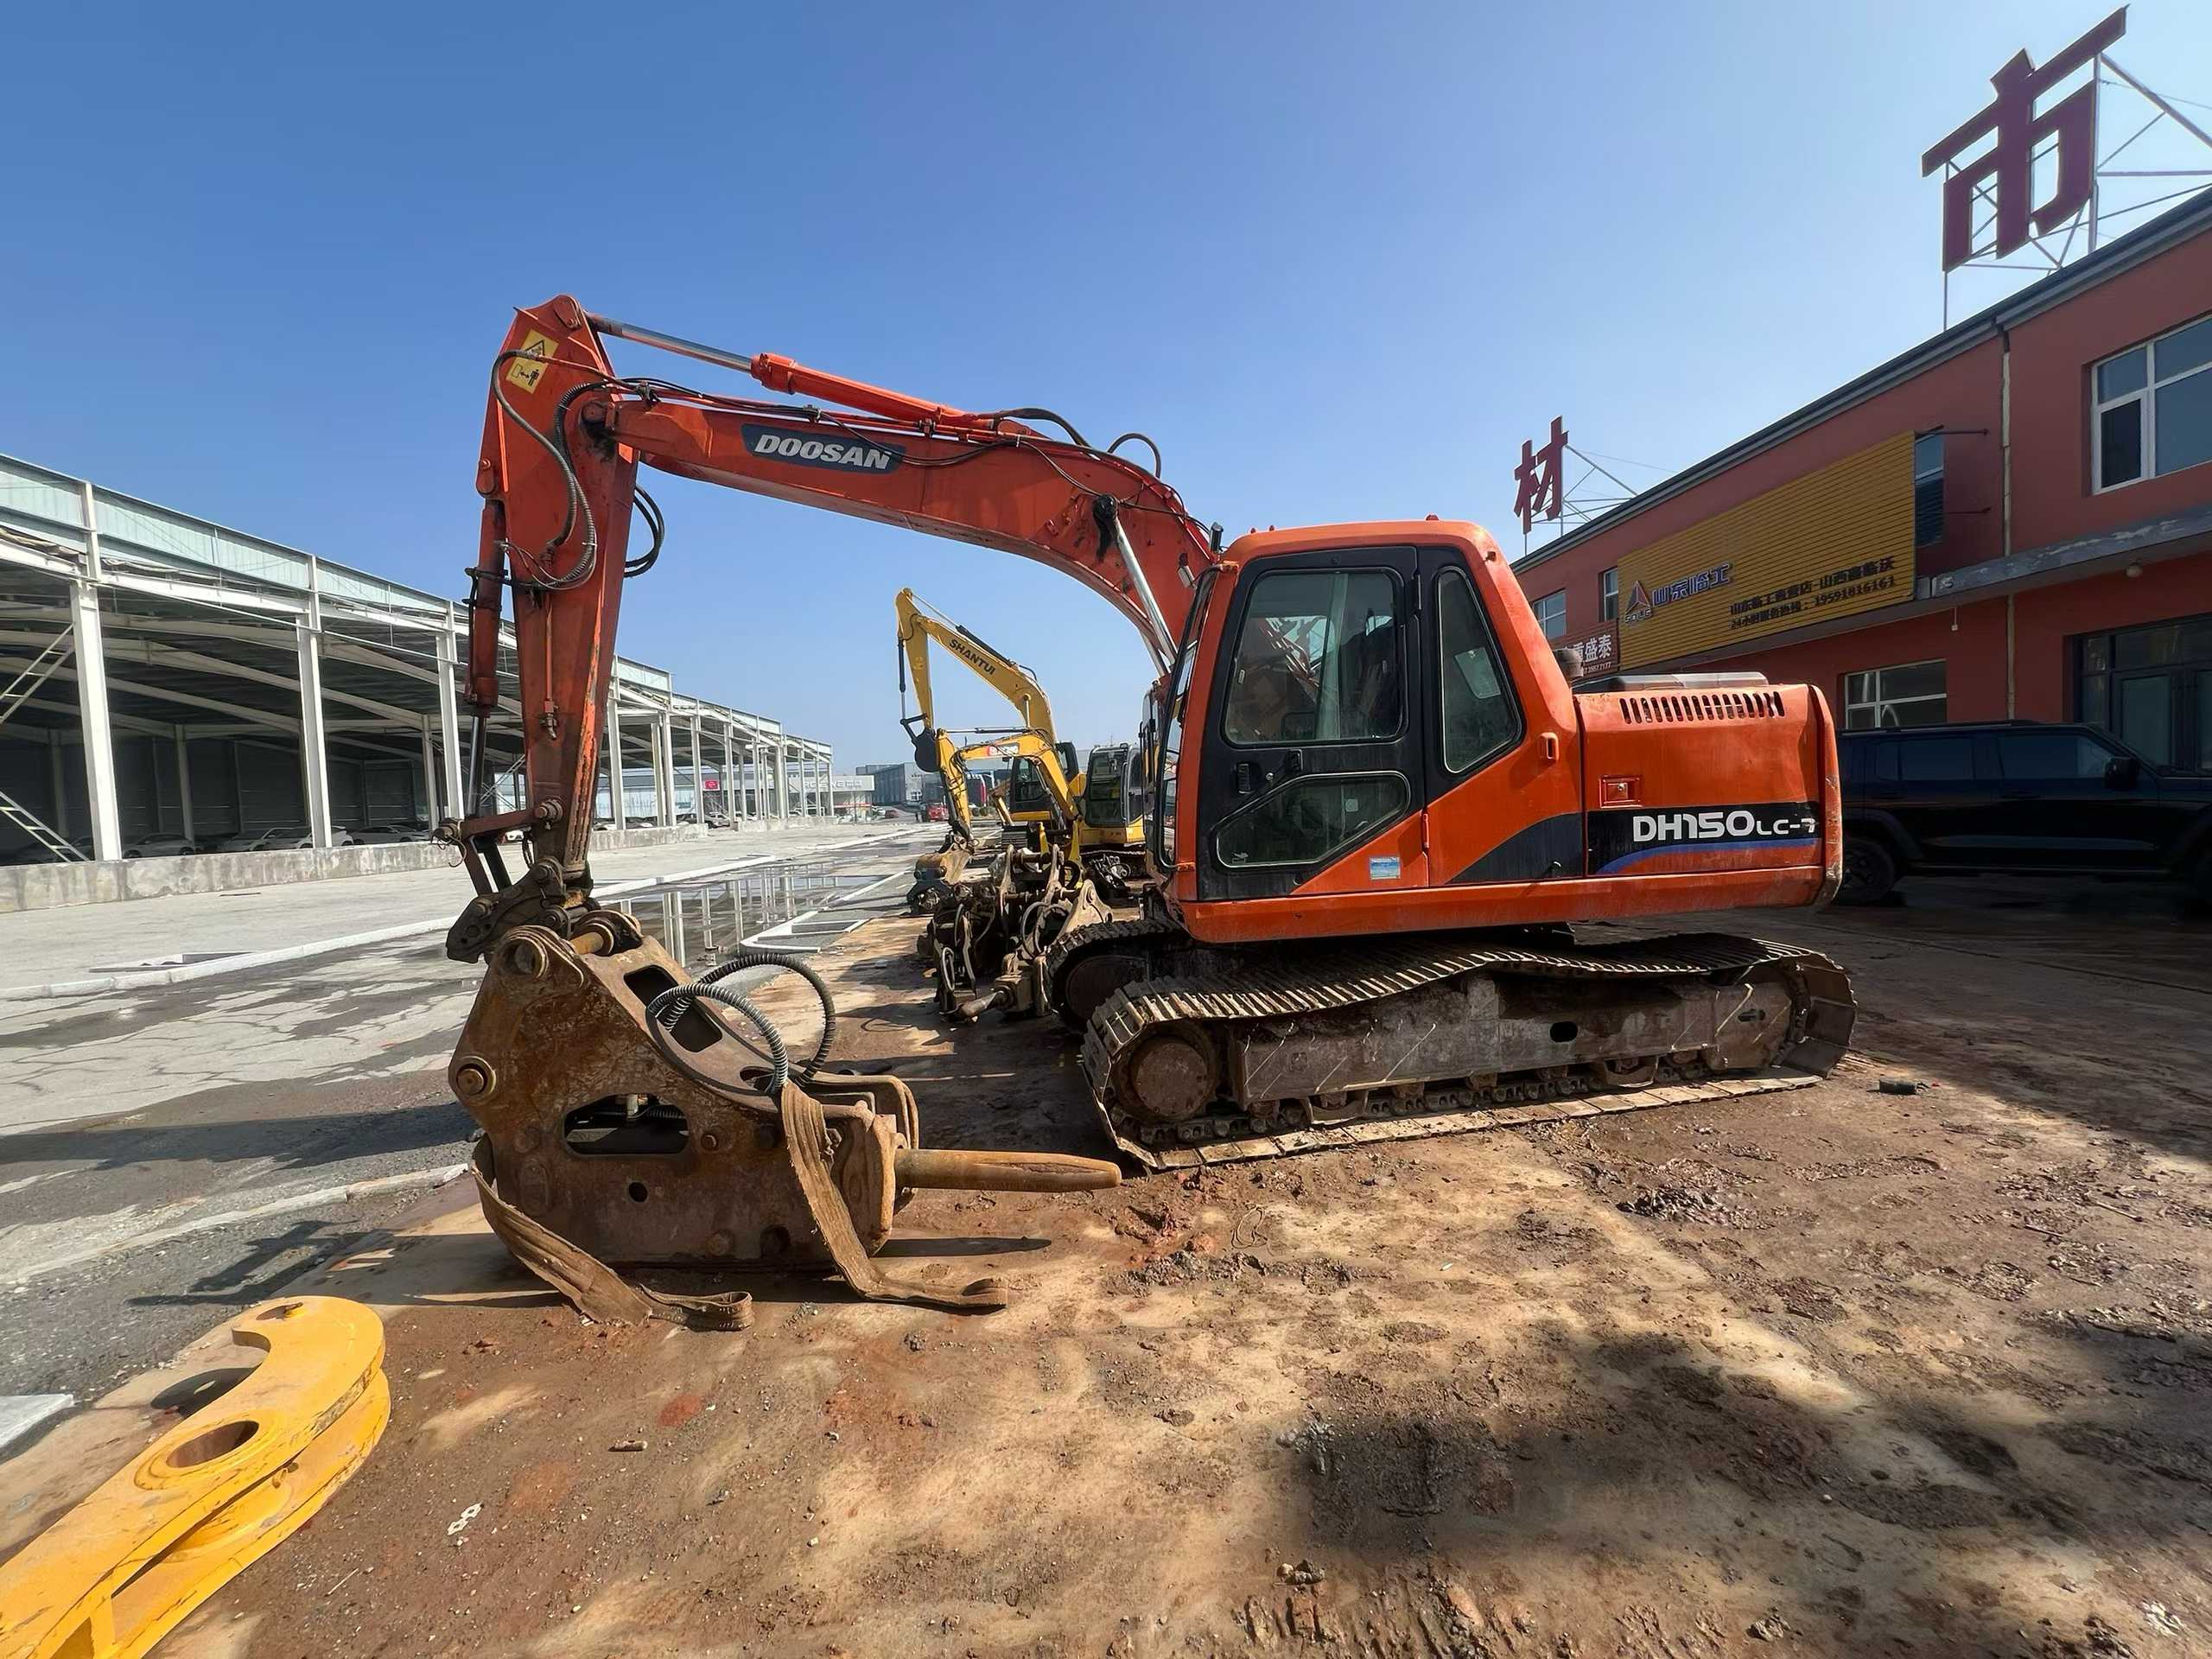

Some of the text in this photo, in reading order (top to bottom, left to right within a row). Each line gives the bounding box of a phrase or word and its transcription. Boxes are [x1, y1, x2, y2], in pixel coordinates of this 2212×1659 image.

[1921, 3, 2131, 273] 市
[754, 434, 892, 469] DOOSAN
[1513, 415, 1569, 535] 材
[1651, 562, 1732, 607] 山东临工
[949, 639, 996, 676] SHANTUI
